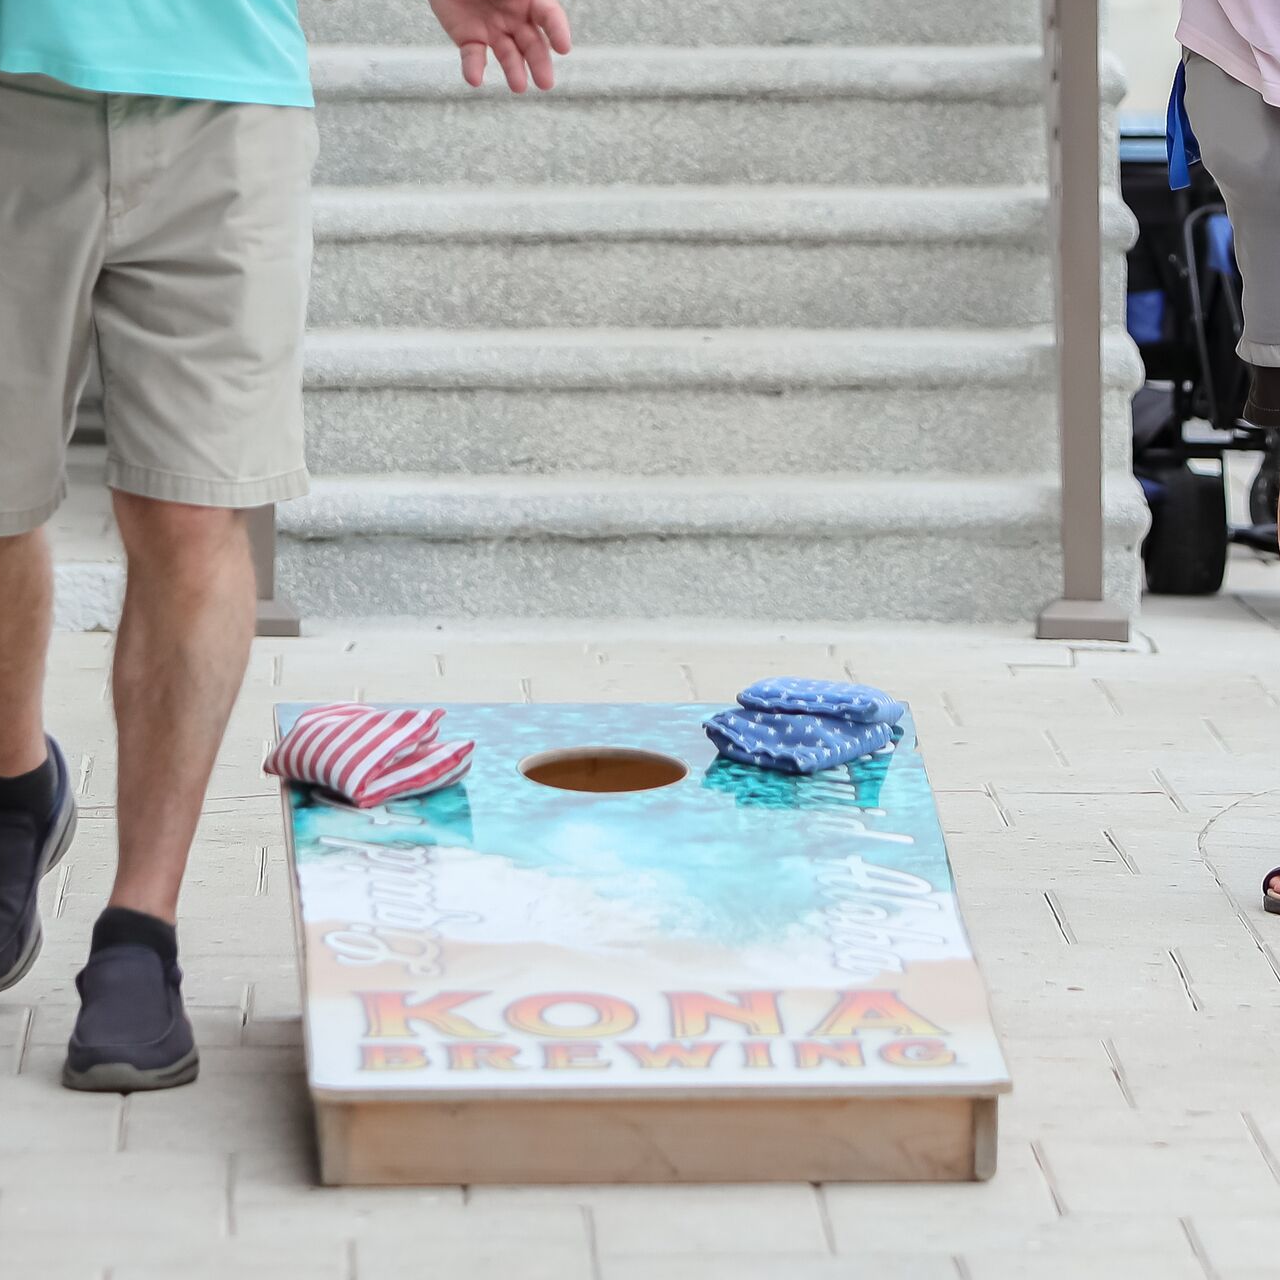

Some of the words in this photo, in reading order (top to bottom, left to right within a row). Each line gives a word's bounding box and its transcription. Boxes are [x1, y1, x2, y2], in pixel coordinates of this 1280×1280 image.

[320, 834, 488, 977] Liquid
[815, 853, 946, 974] Aloha
[352, 989, 954, 1039] KONA
[356, 1038, 961, 1072] BREWING
